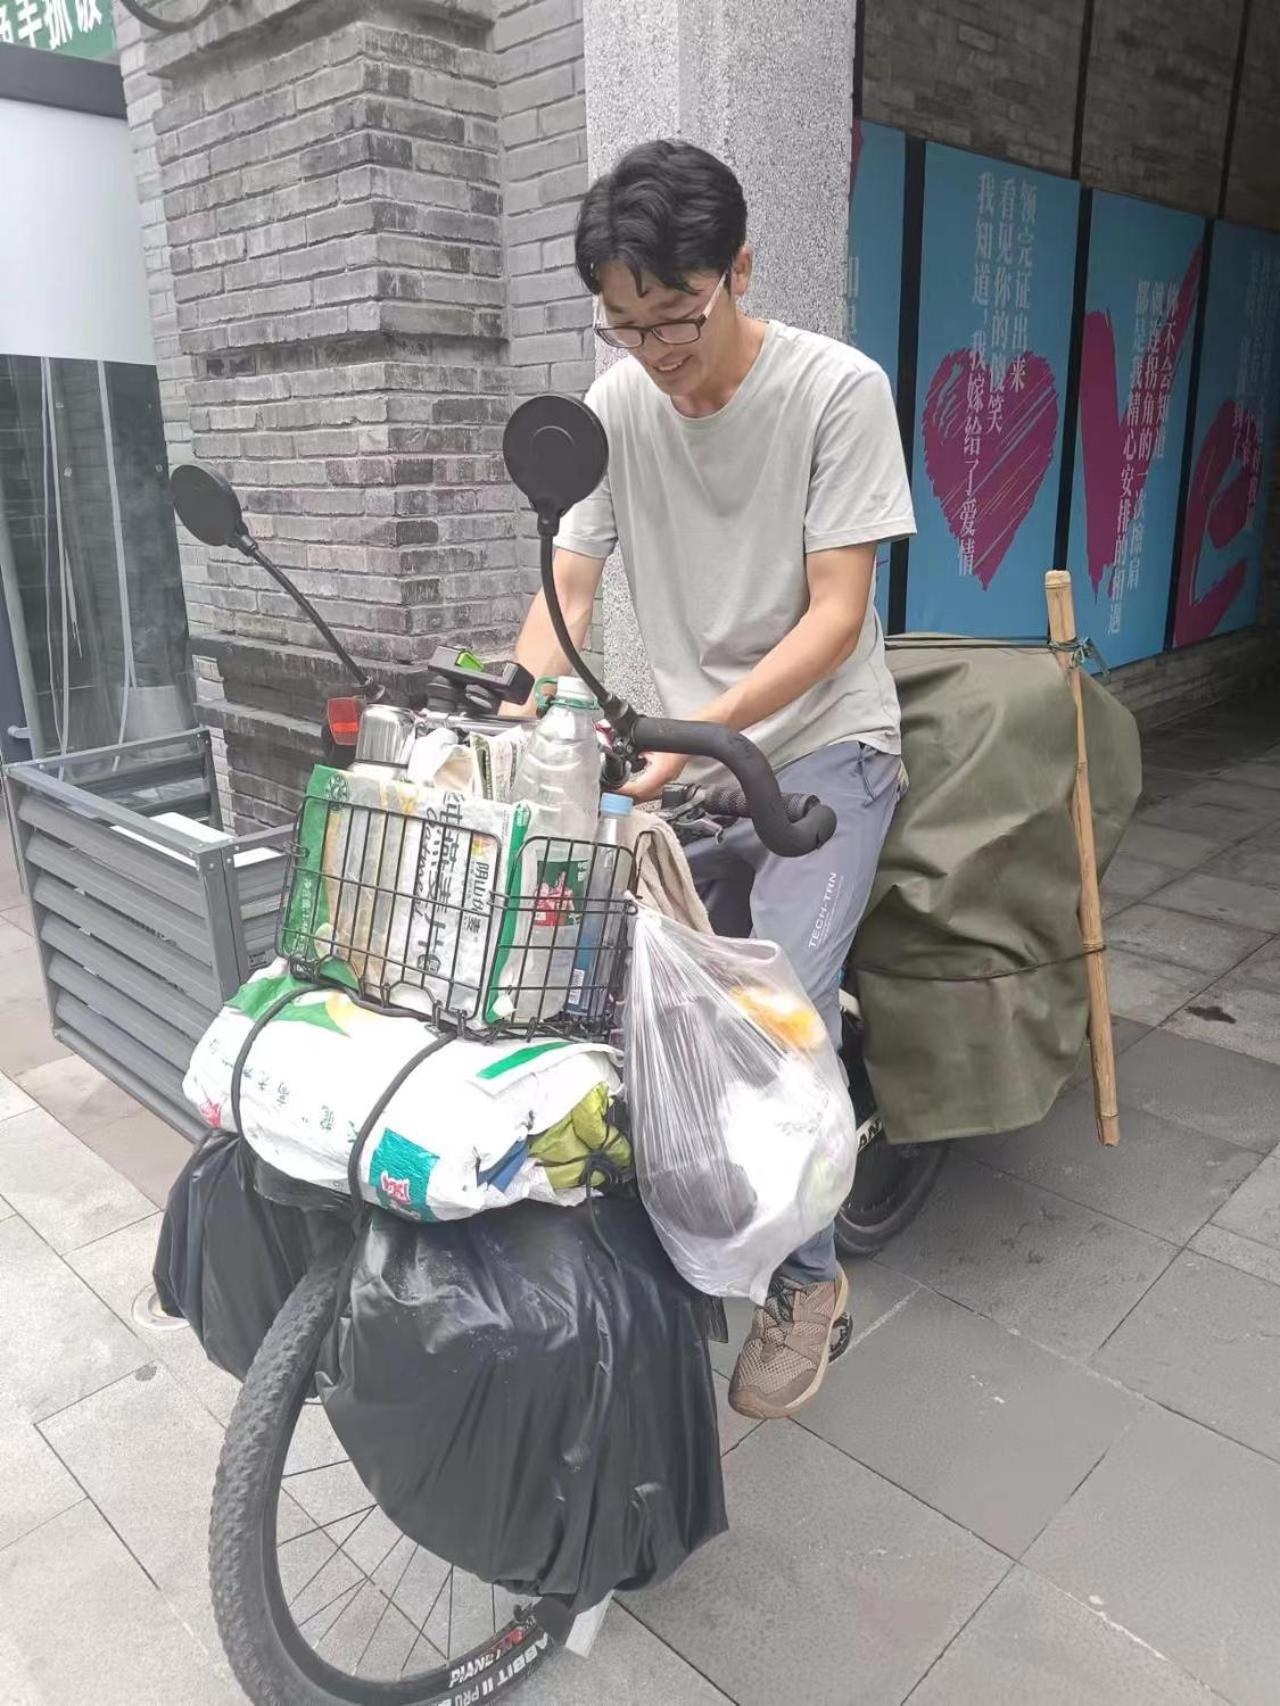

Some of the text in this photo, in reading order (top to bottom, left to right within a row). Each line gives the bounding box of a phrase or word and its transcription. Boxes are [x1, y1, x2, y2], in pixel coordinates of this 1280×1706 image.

[1009, 180, 1038, 393] 领完证出来
